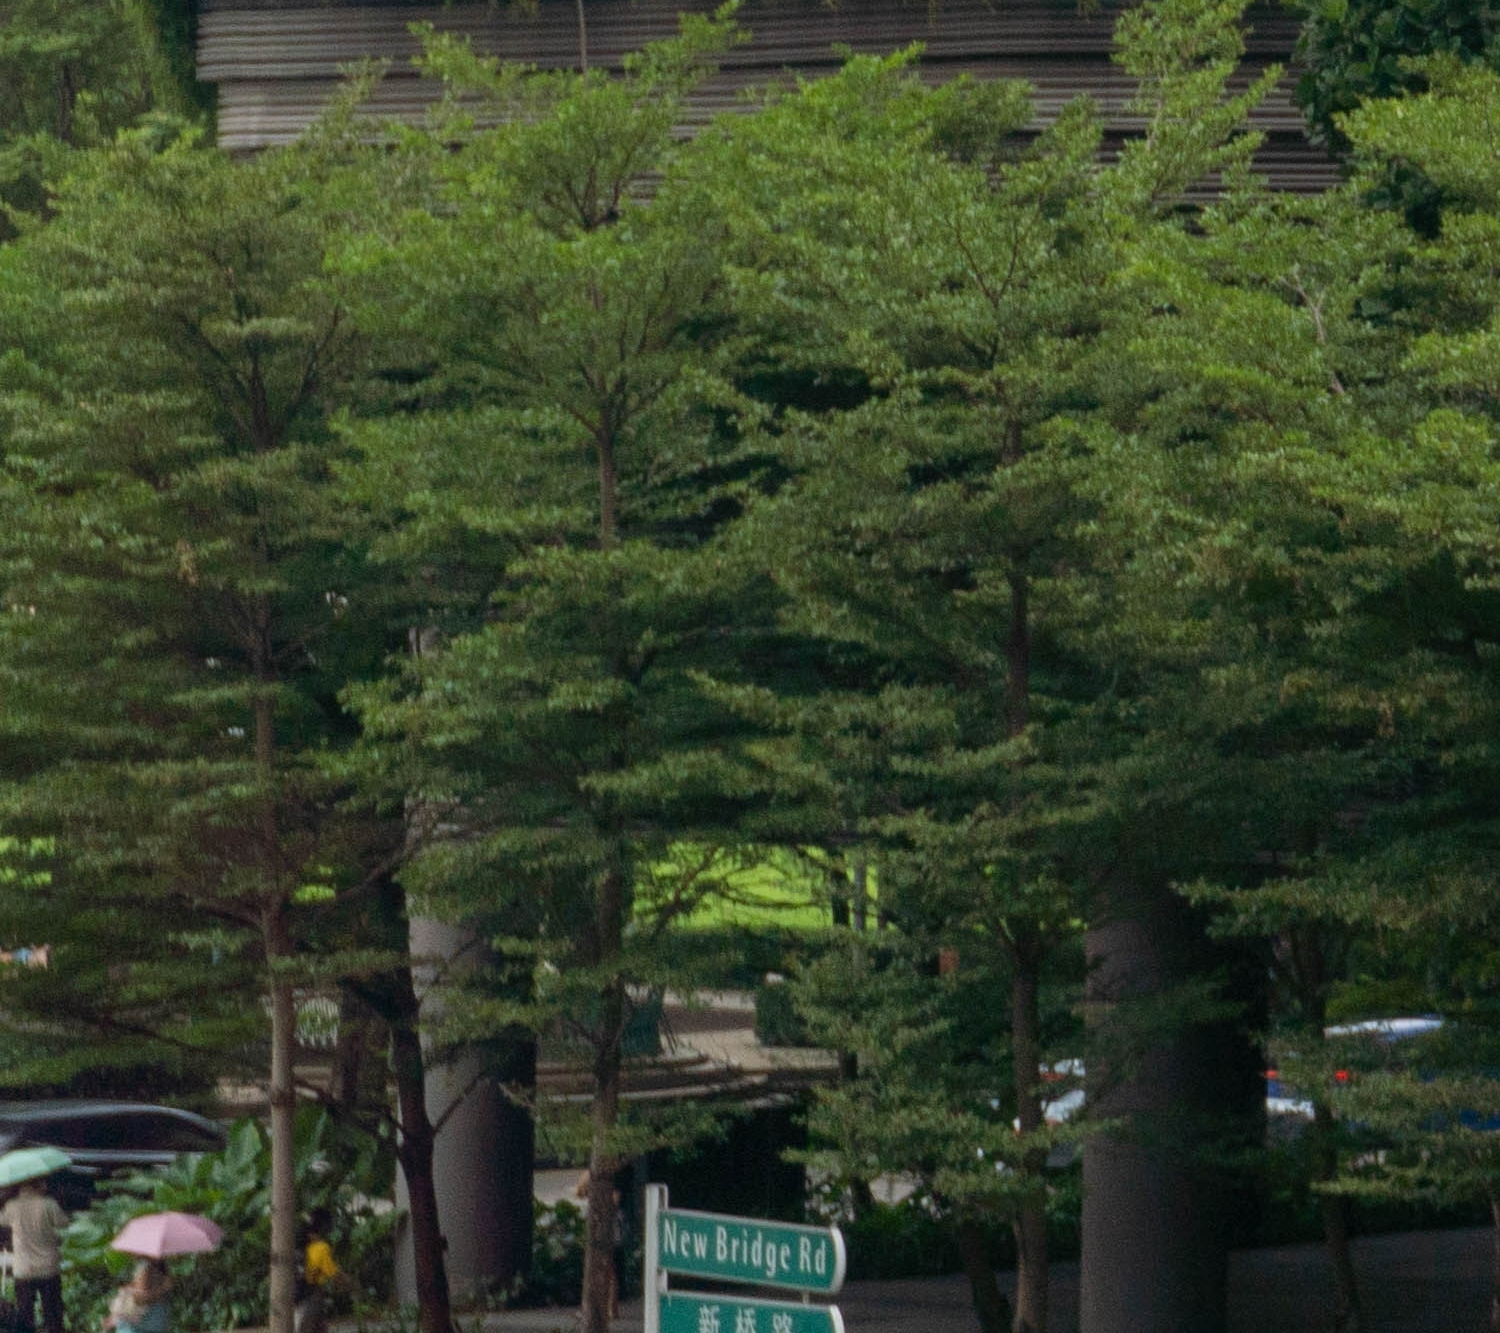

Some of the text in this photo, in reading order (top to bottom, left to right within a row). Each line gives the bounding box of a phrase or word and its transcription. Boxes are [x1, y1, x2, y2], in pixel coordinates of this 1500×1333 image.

[664, 1219, 826, 1277] New Bridge Rd
